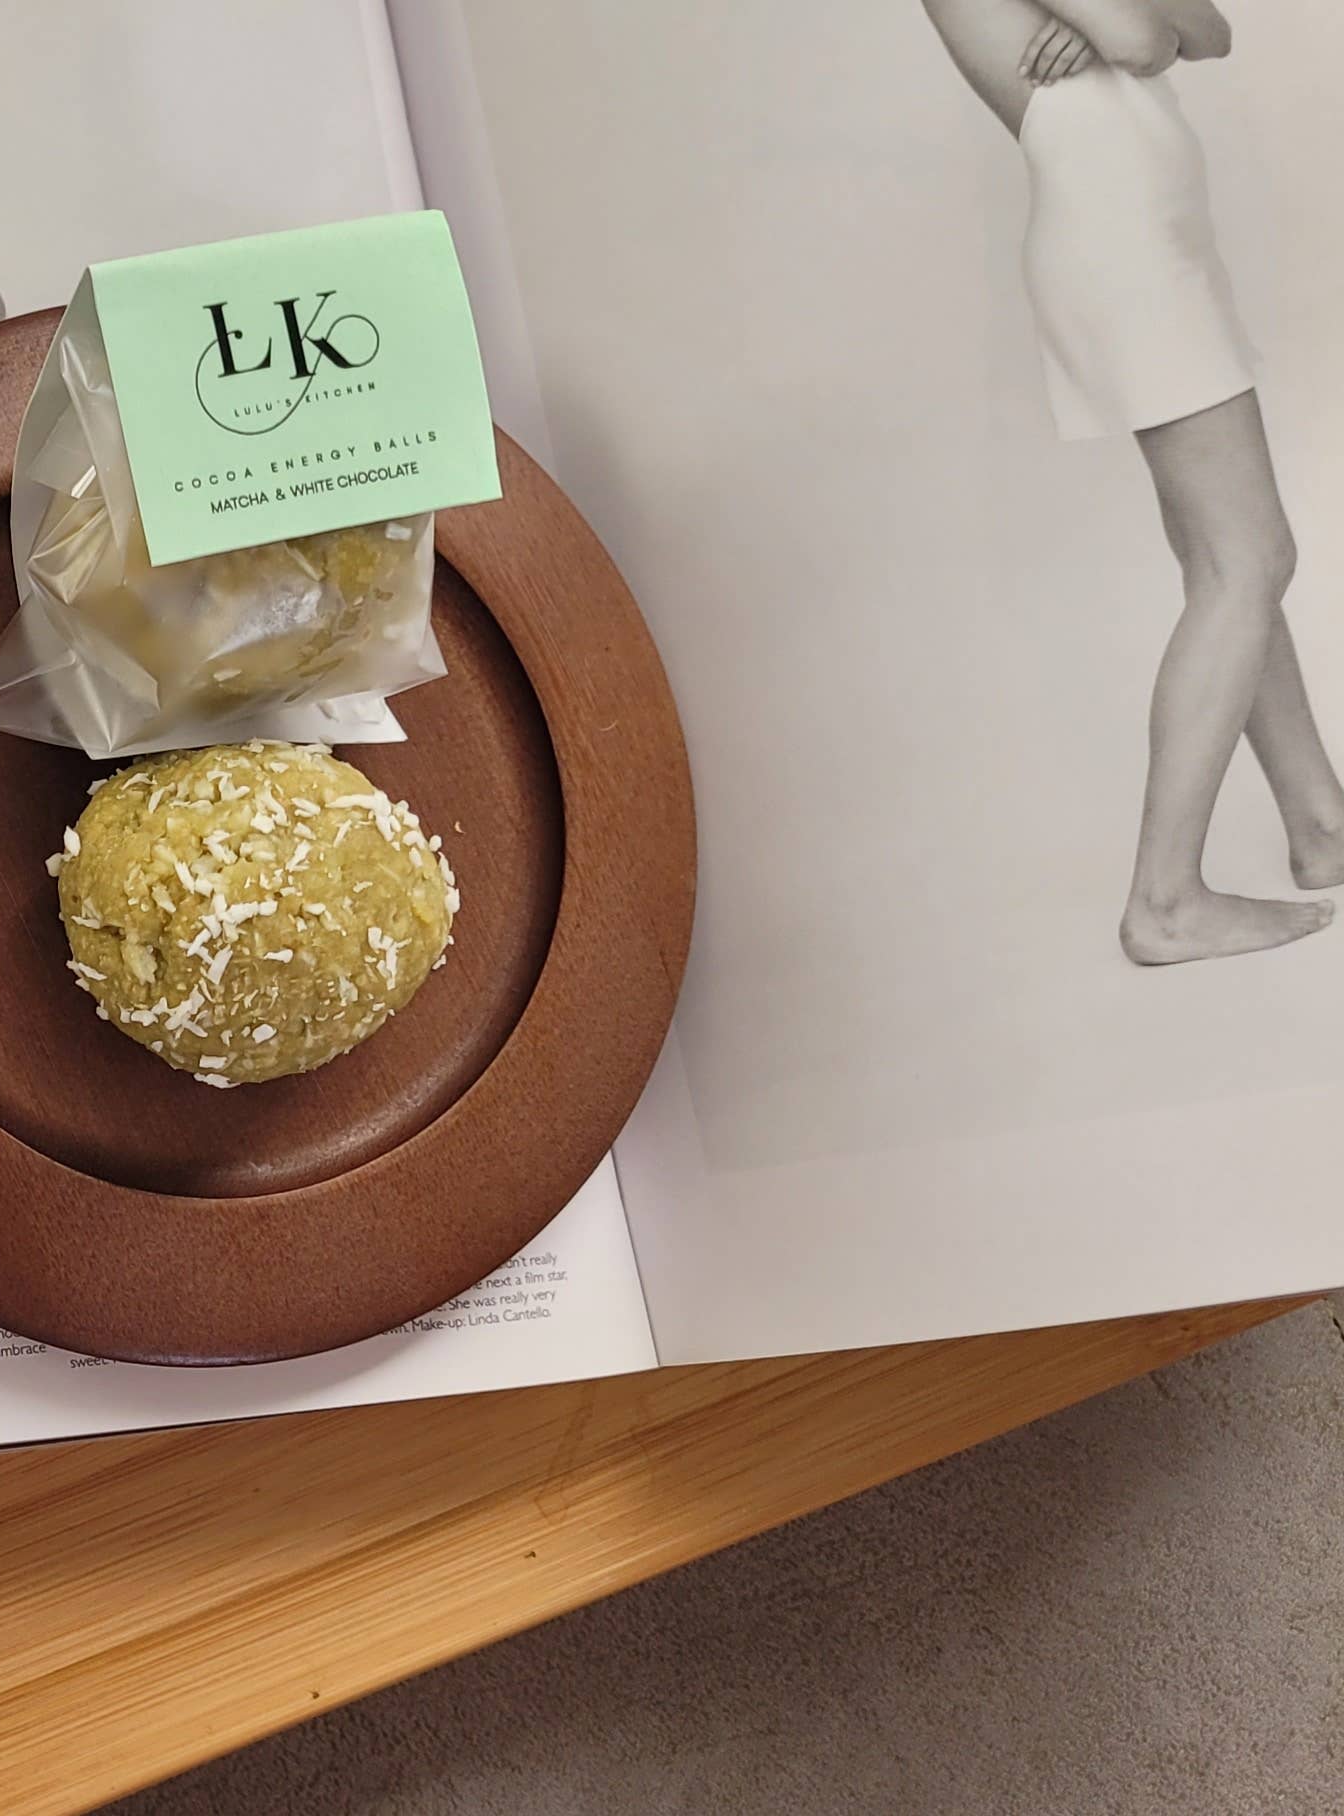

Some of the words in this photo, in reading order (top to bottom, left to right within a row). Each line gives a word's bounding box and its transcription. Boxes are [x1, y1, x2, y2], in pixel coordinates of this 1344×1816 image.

[234, 398, 293, 417] LULU'S
[305, 382, 376, 403] KITCHEN
[174, 467, 253, 492] COCOA
[270, 446, 356, 473] ENERGY
[373, 431, 438, 452] BALLS
[210, 491, 269, 514] MATCHA
[275, 488, 286, 501] &
[289, 477, 334, 498] WHITE
[336, 461, 420, 489] CHOCOLATE
[529, 1251, 558, 1267] really
[486, 1278, 513, 1290] next
[515, 1276, 522, 1286] a
[524, 1271, 544, 1284] film
[448, 1295, 470, 1310] She
[473, 1296, 496, 1308] was
[499, 1290, 529, 1308] really
[531, 1289, 556, 1303] very
[411, 1314, 466, 1334] Make-up:
[468, 1311, 500, 1326] Linda
